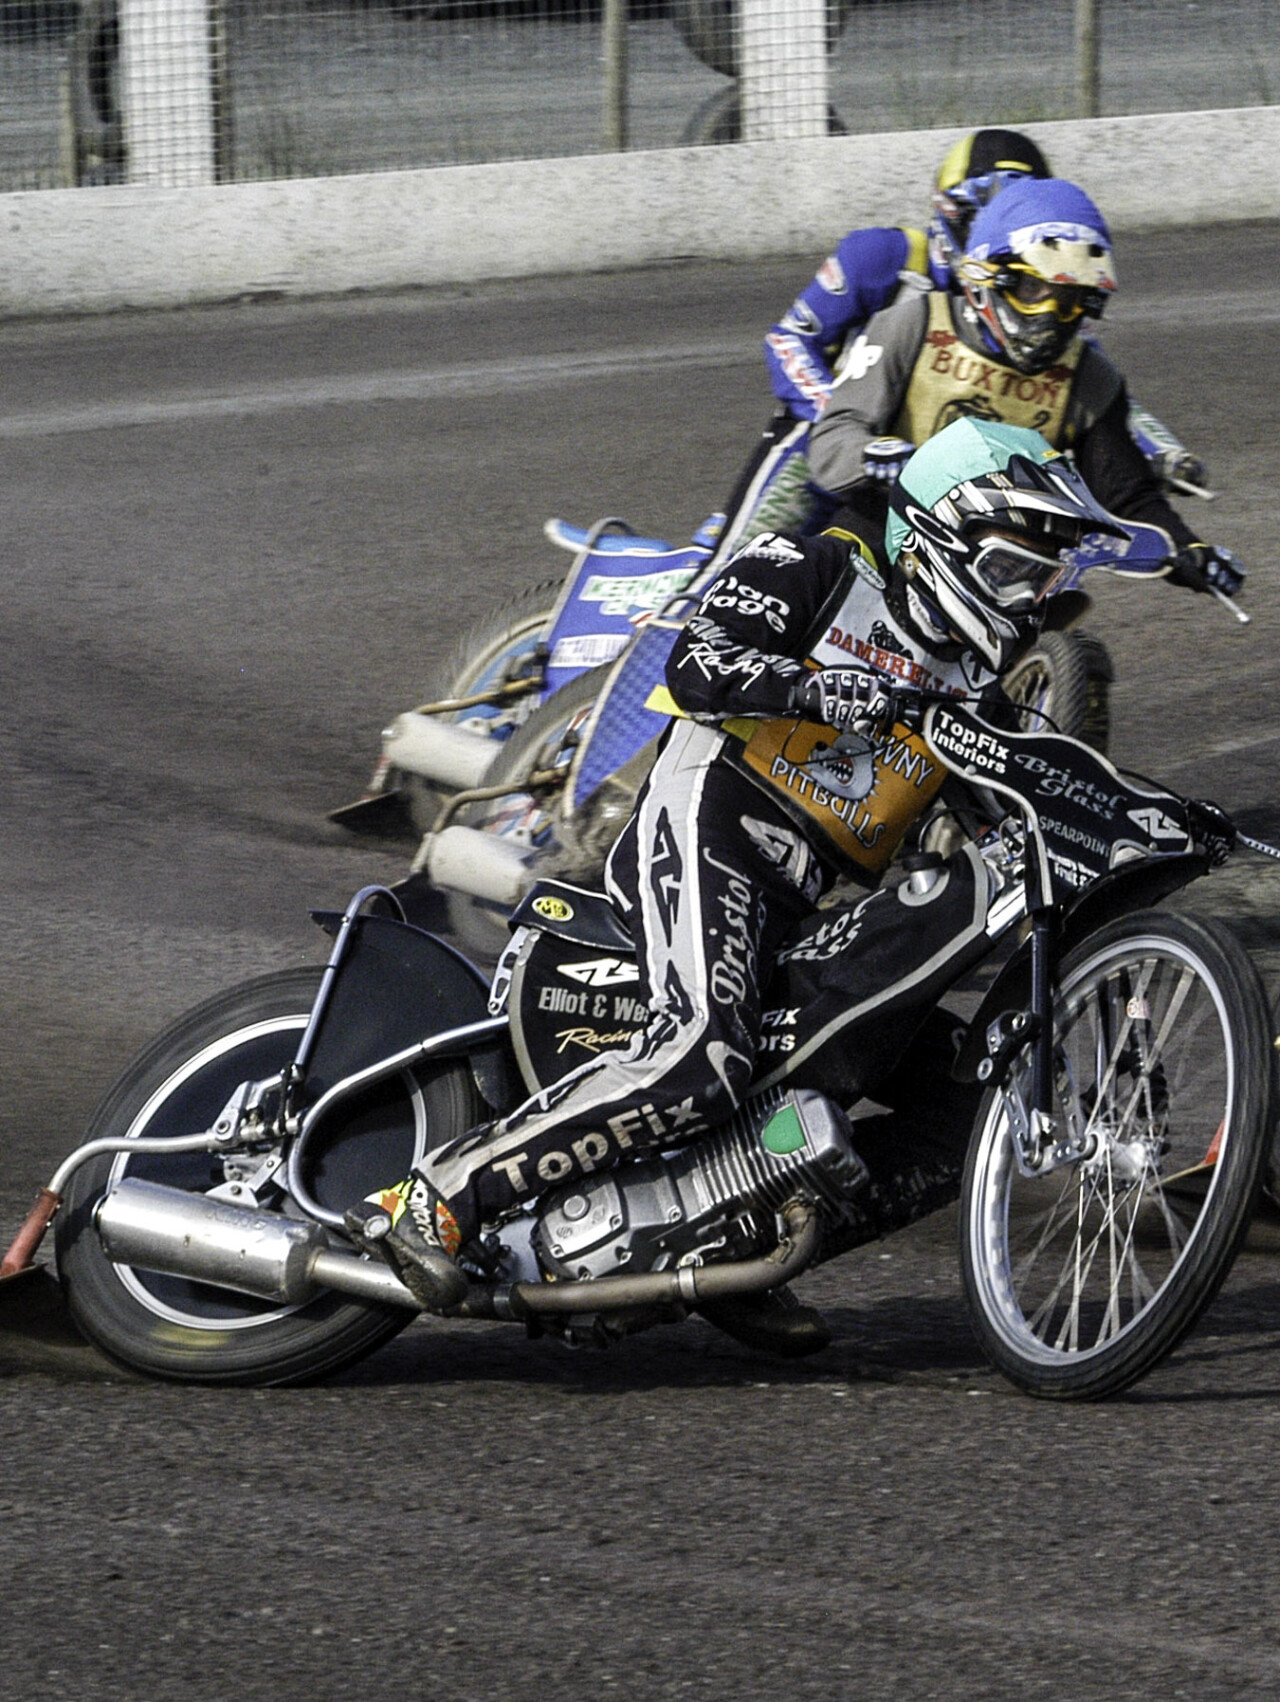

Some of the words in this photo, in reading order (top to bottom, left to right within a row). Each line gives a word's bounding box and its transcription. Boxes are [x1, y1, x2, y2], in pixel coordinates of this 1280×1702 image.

[930, 350, 1061, 408] BUXTON
[932, 727, 1007, 775] interiors
[938, 710, 1011, 760] TopFix
[770, 754, 886, 848] PITBULLS
[1013, 753, 1128, 810] Bristol
[1035, 778, 1115, 821] Glass
[706, 846, 752, 1005] Bristol
[538, 986, 589, 1015] Elliot
[592, 993, 607, 1019] &
[555, 1027, 632, 1054] Racin
[492, 1095, 703, 1194] TopFix
